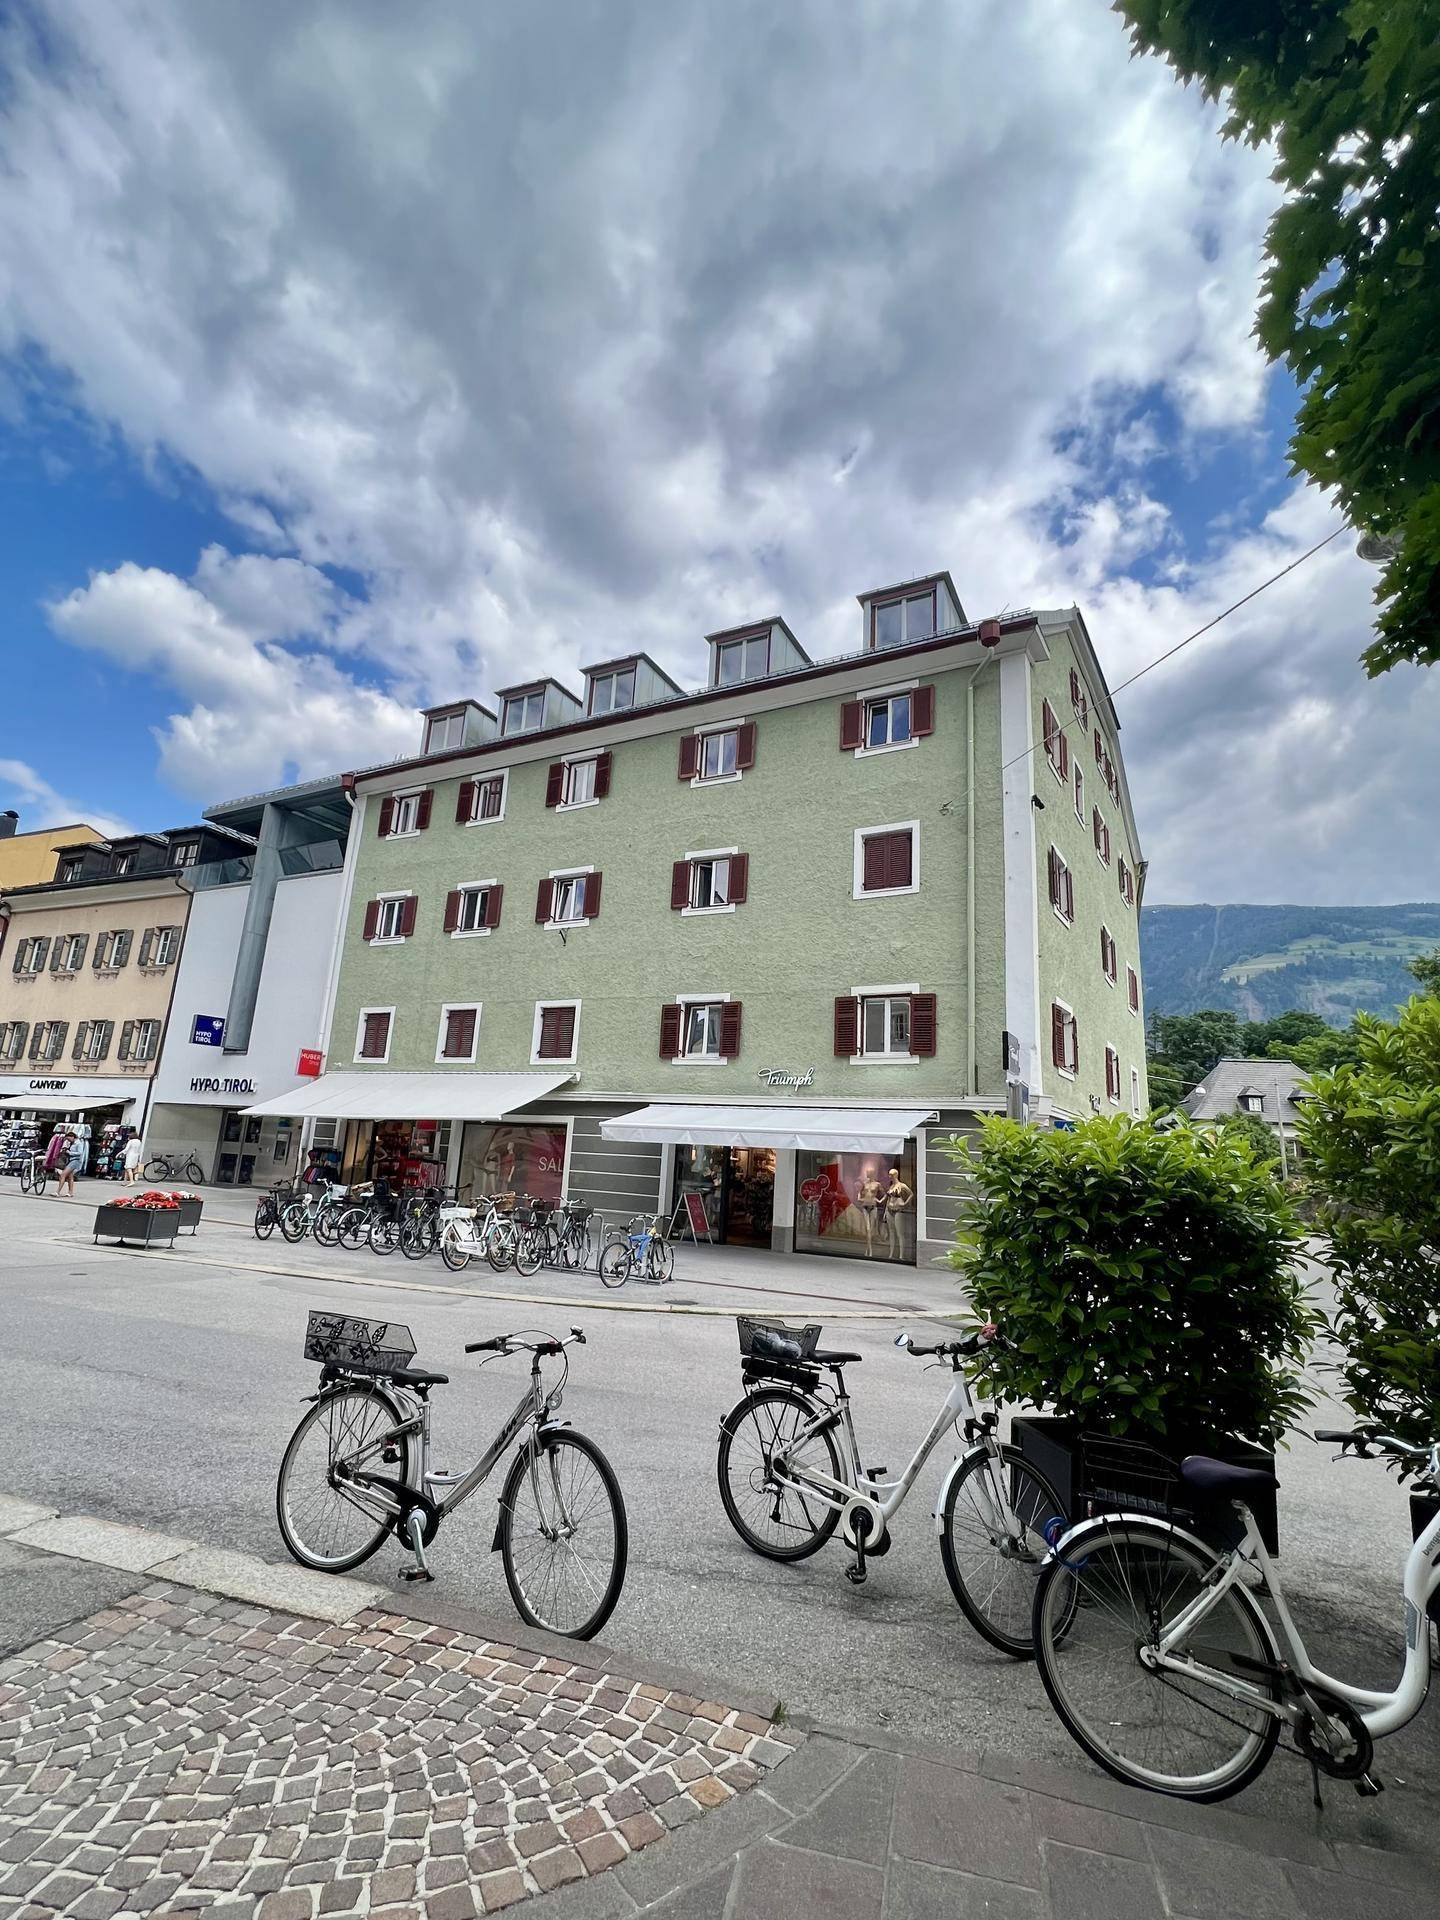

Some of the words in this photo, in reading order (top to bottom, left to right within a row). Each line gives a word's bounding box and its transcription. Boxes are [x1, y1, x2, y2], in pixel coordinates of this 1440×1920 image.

[195, 1036, 212, 1044] TIROL
[301, 1052, 321, 1060] HUBER
[758, 1067, 813, 1091] Triumph
[190, 1078, 220, 1092] HYPO
[223, 1079, 254, 1093] TIROL
